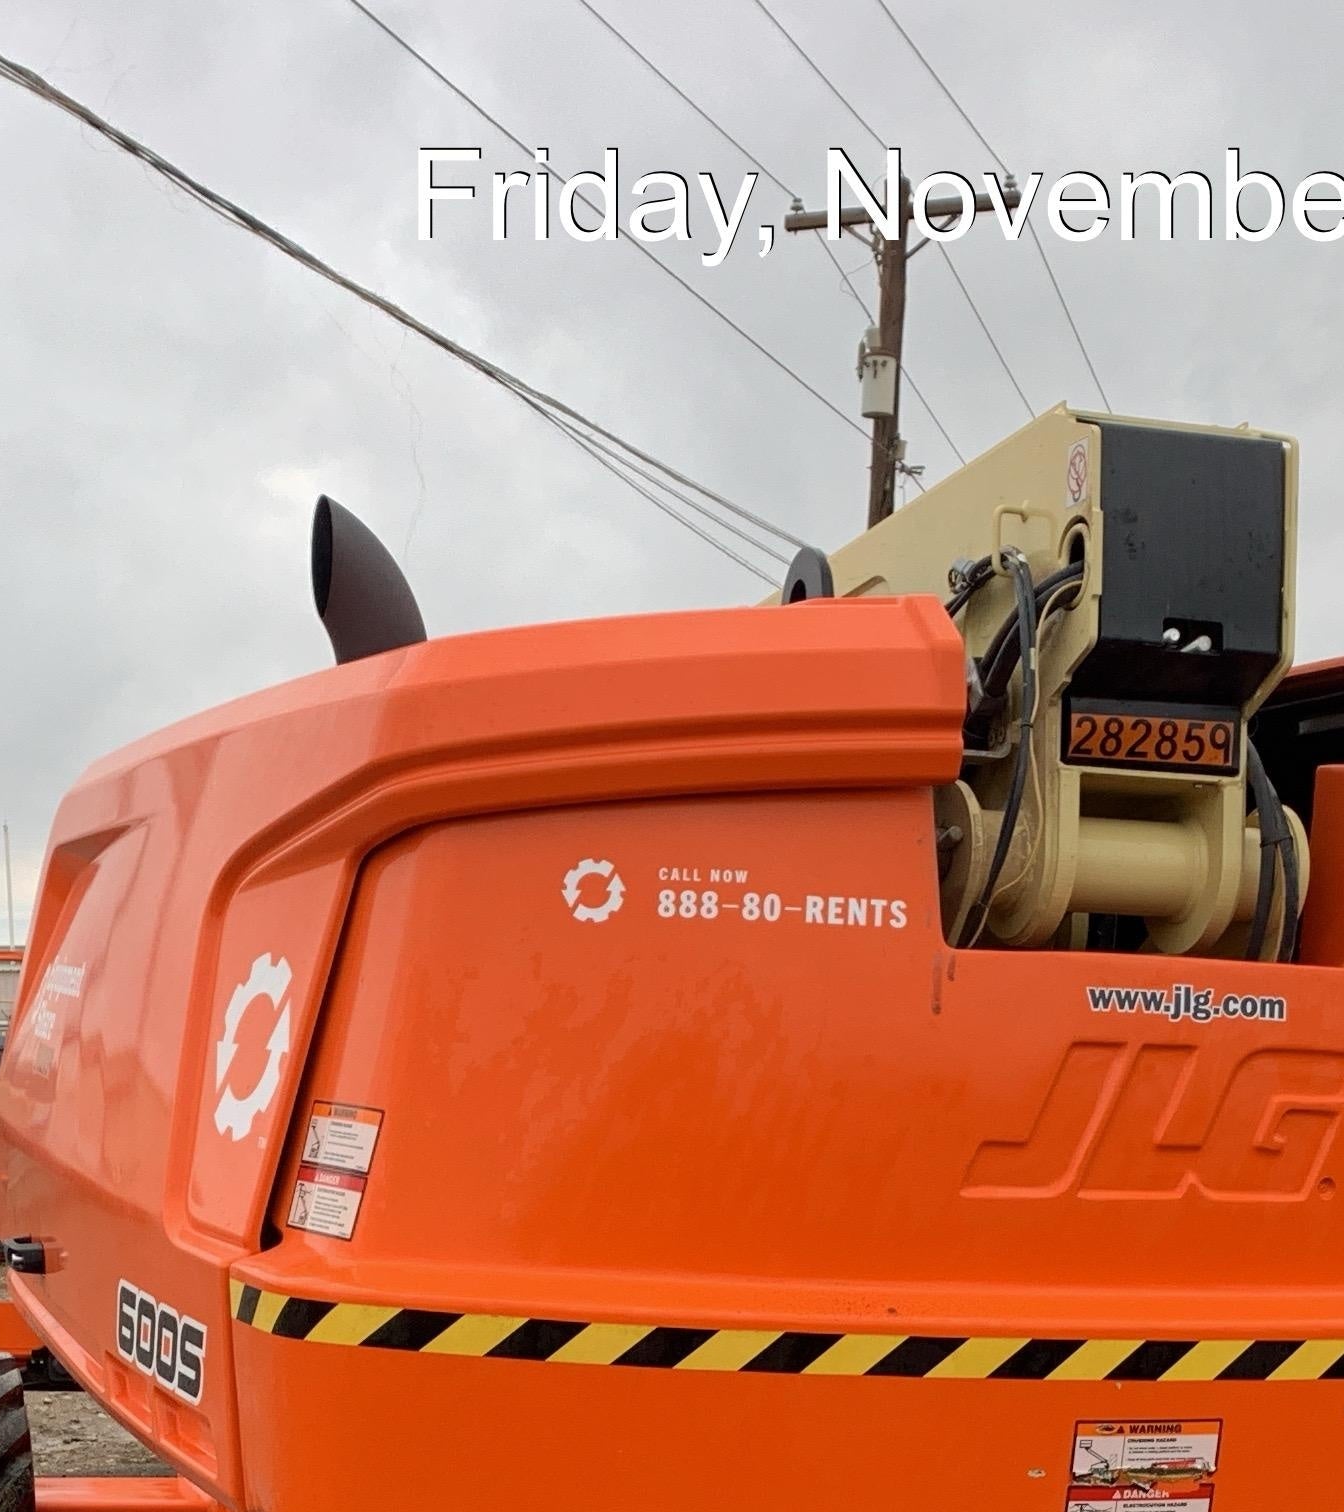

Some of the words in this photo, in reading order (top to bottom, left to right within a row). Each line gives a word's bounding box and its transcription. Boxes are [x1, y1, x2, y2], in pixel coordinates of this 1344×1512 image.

[1069, 715, 1231, 765] 282859
[658, 867, 702, 883] CALL
[710, 869, 749, 885] NOW
[657, 889, 908, 929] 888-80-RENTS
[1087, 984, 1286, 1022] www.jlg.com
[116, 1278, 208, 1407] 600S
[1128, 1423, 1183, 1434] WARNING
